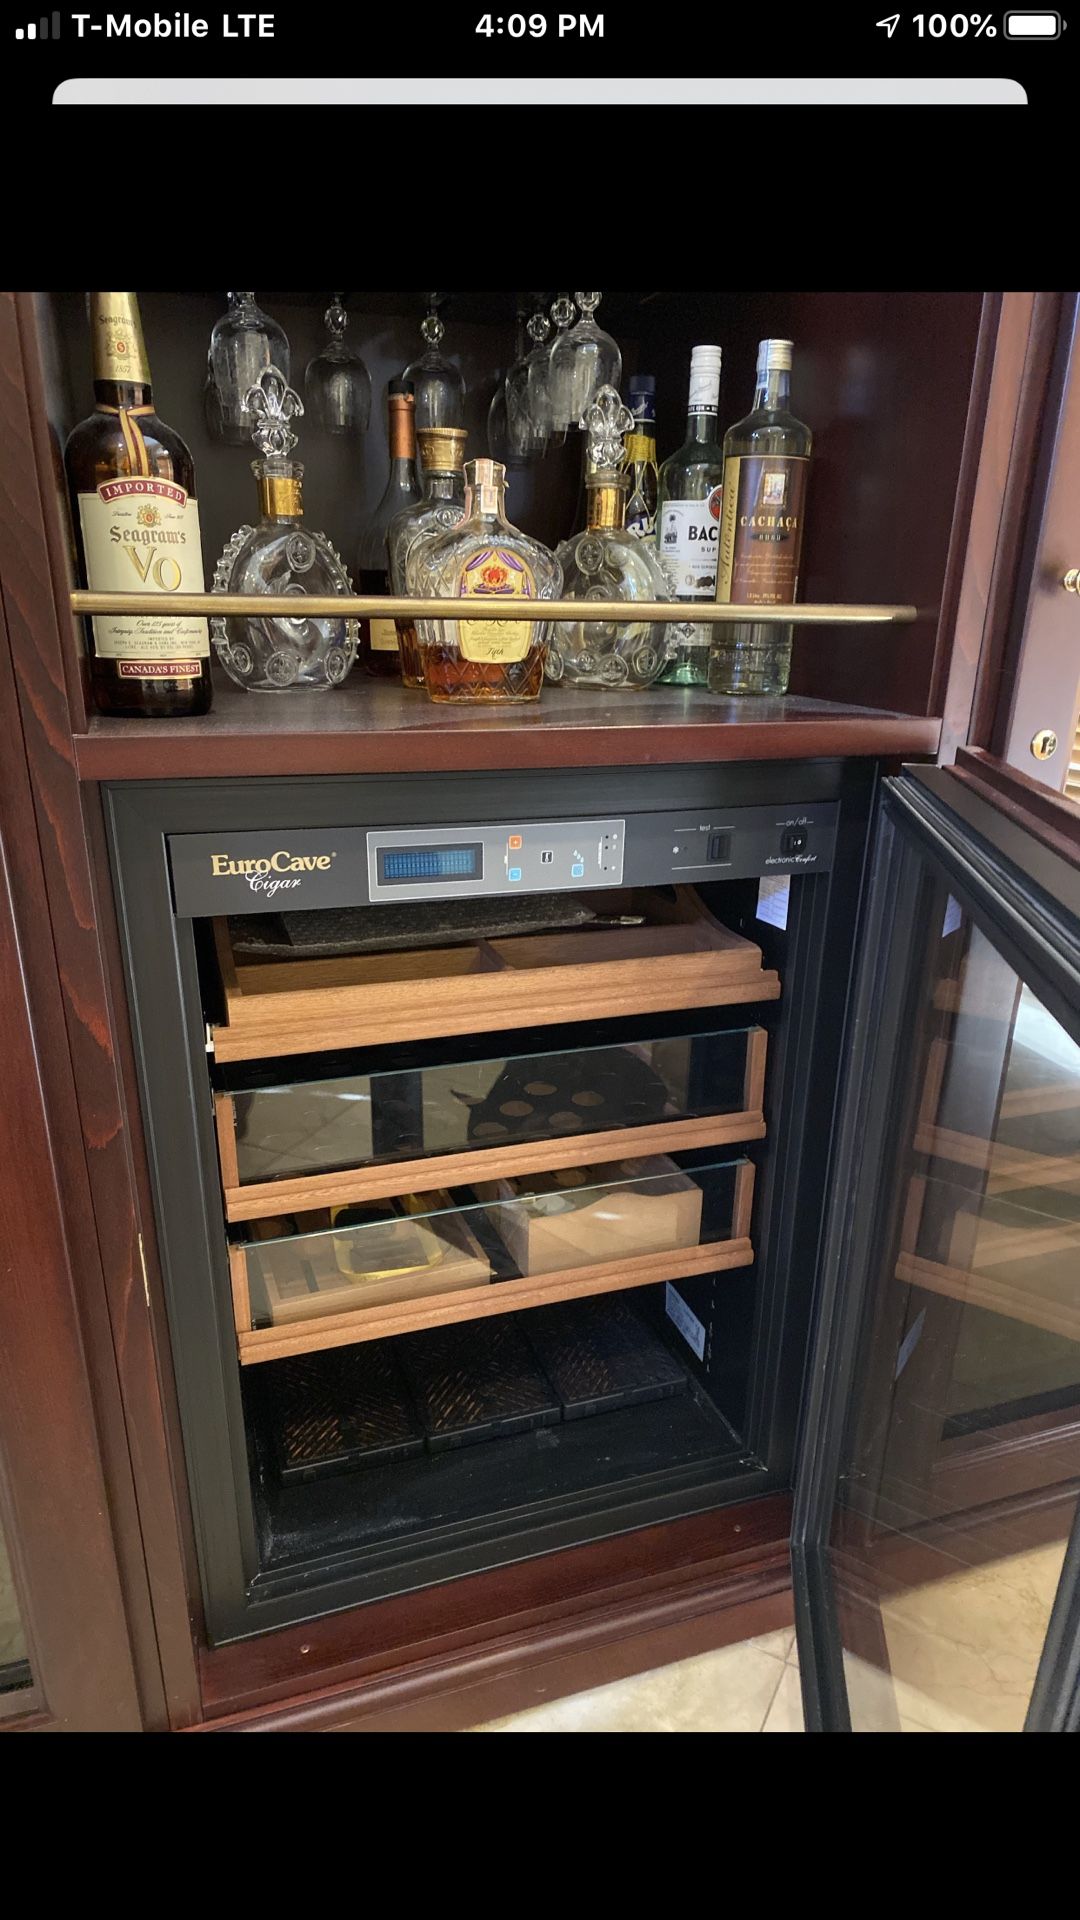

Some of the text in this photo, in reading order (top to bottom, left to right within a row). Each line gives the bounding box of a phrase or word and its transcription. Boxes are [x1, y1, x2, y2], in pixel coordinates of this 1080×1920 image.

[105, 483, 182, 501] IMPORTED
[740, 515, 798, 531] CACHAÇA
[109, 525, 186, 545] Seagram's
[122, 545, 182, 592] VO
[122, 664, 200, 674] CANADA'S FINEST
[210, 850, 331, 876] EuroCave
[245, 870, 302, 898] Cigar
